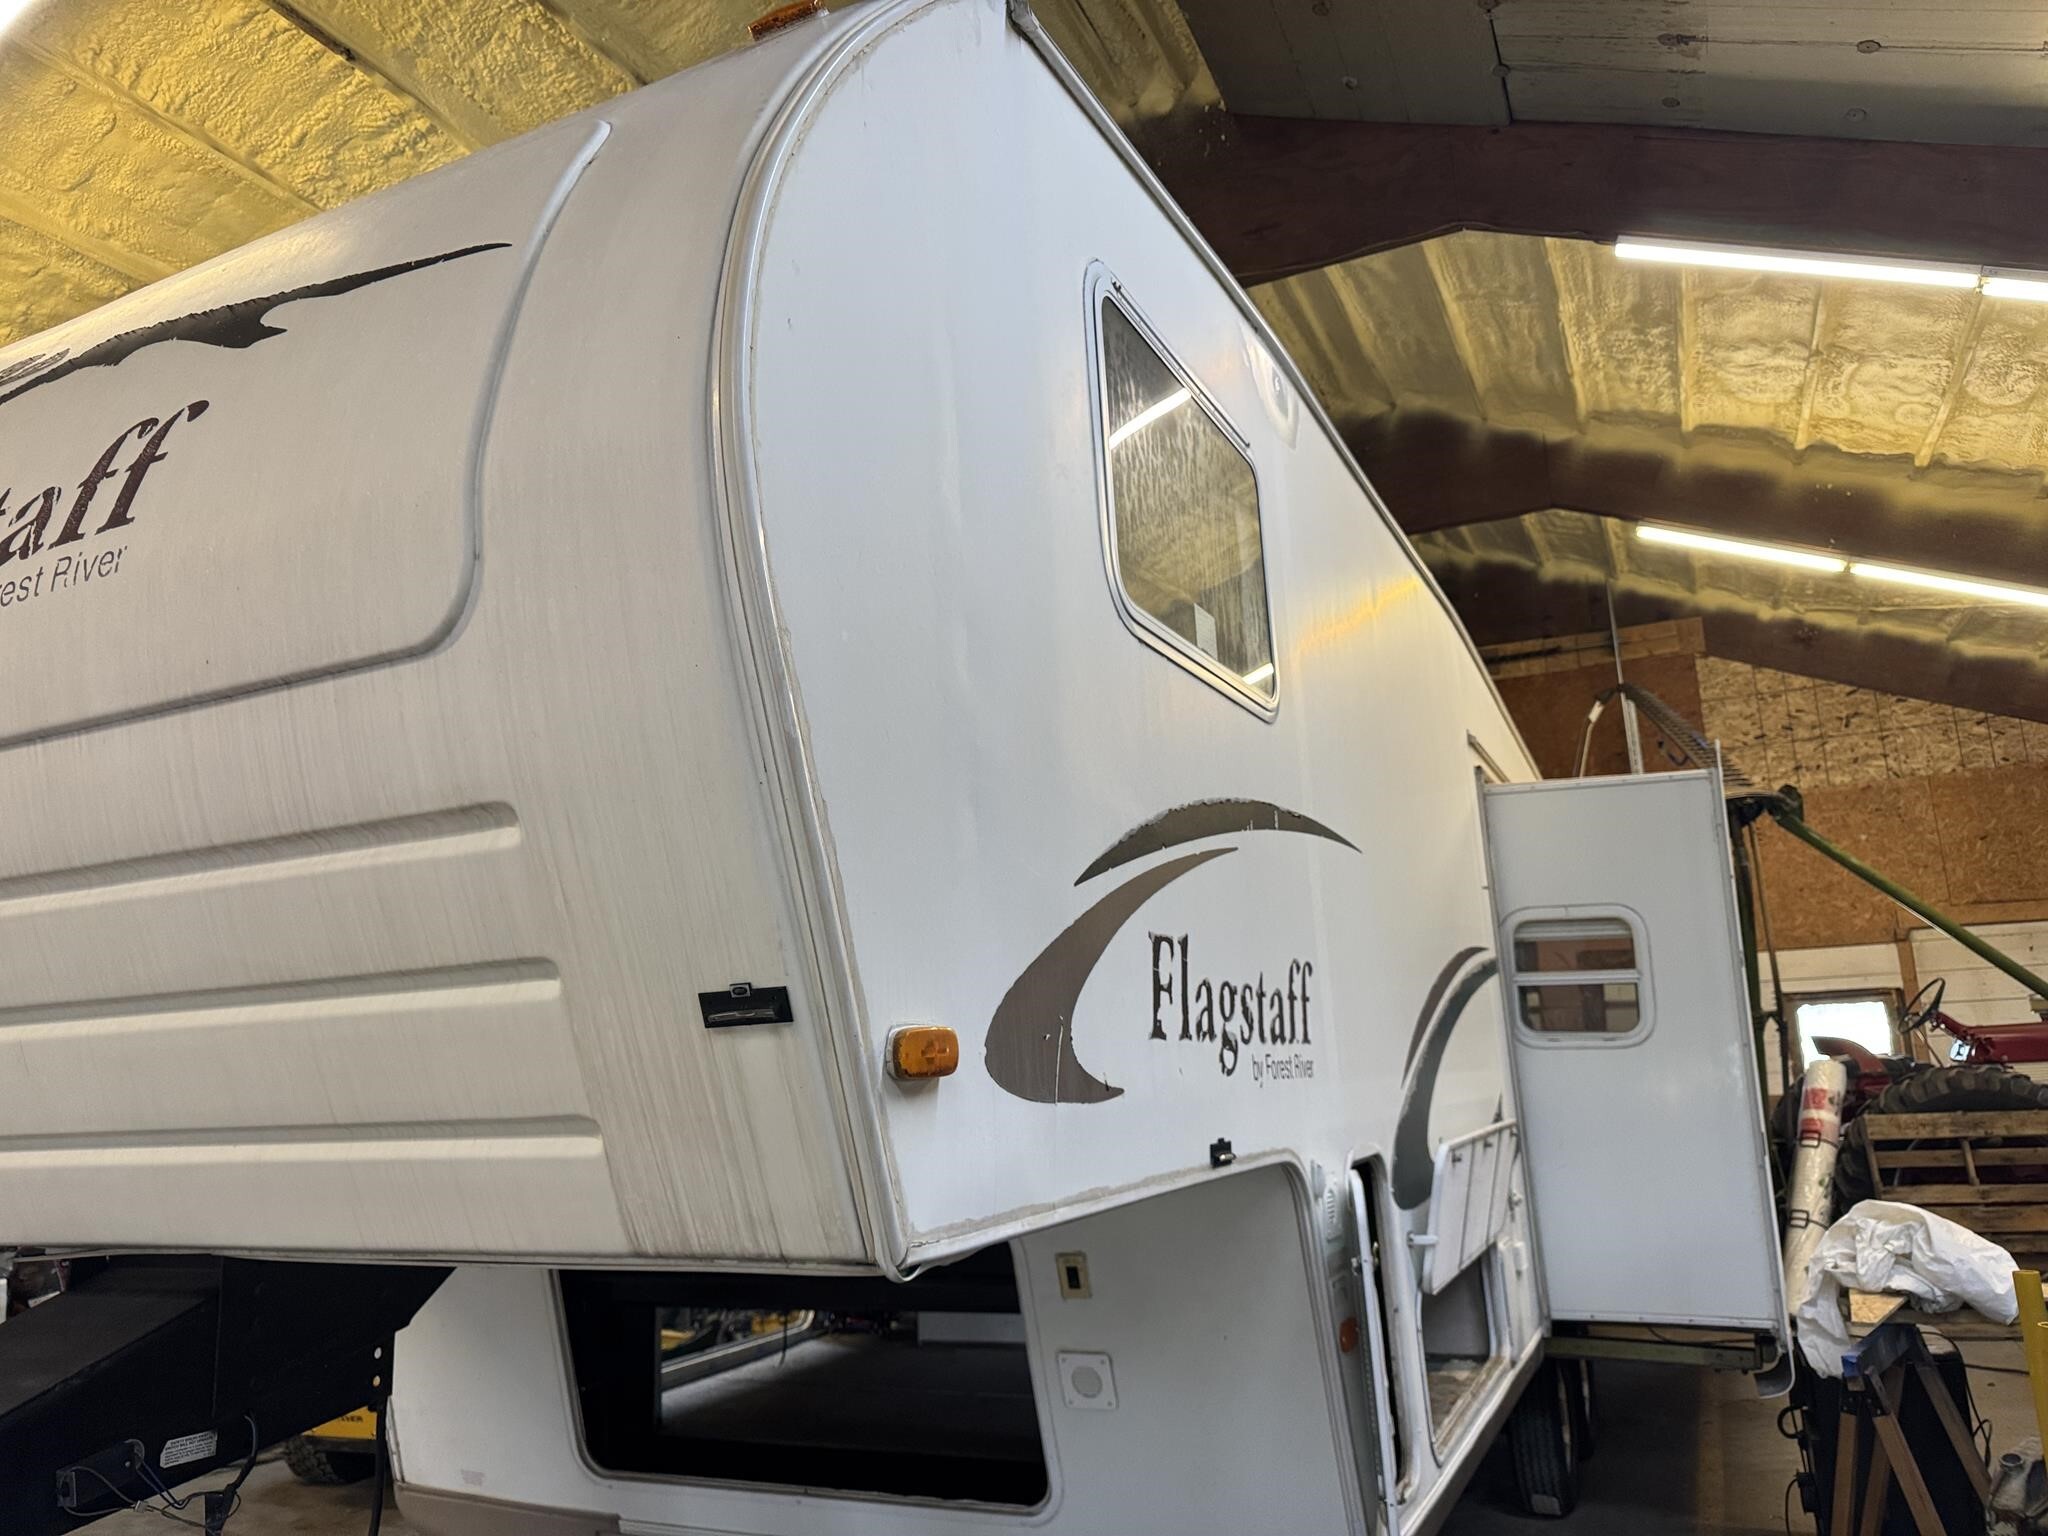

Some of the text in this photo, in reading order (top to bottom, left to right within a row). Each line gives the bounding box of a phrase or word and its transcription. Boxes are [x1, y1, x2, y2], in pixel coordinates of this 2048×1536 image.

[0, 545, 128, 607] est River
[1148, 931, 1313, 1077] Flagstaff
[1251, 1053, 1315, 1089] by Forest River
